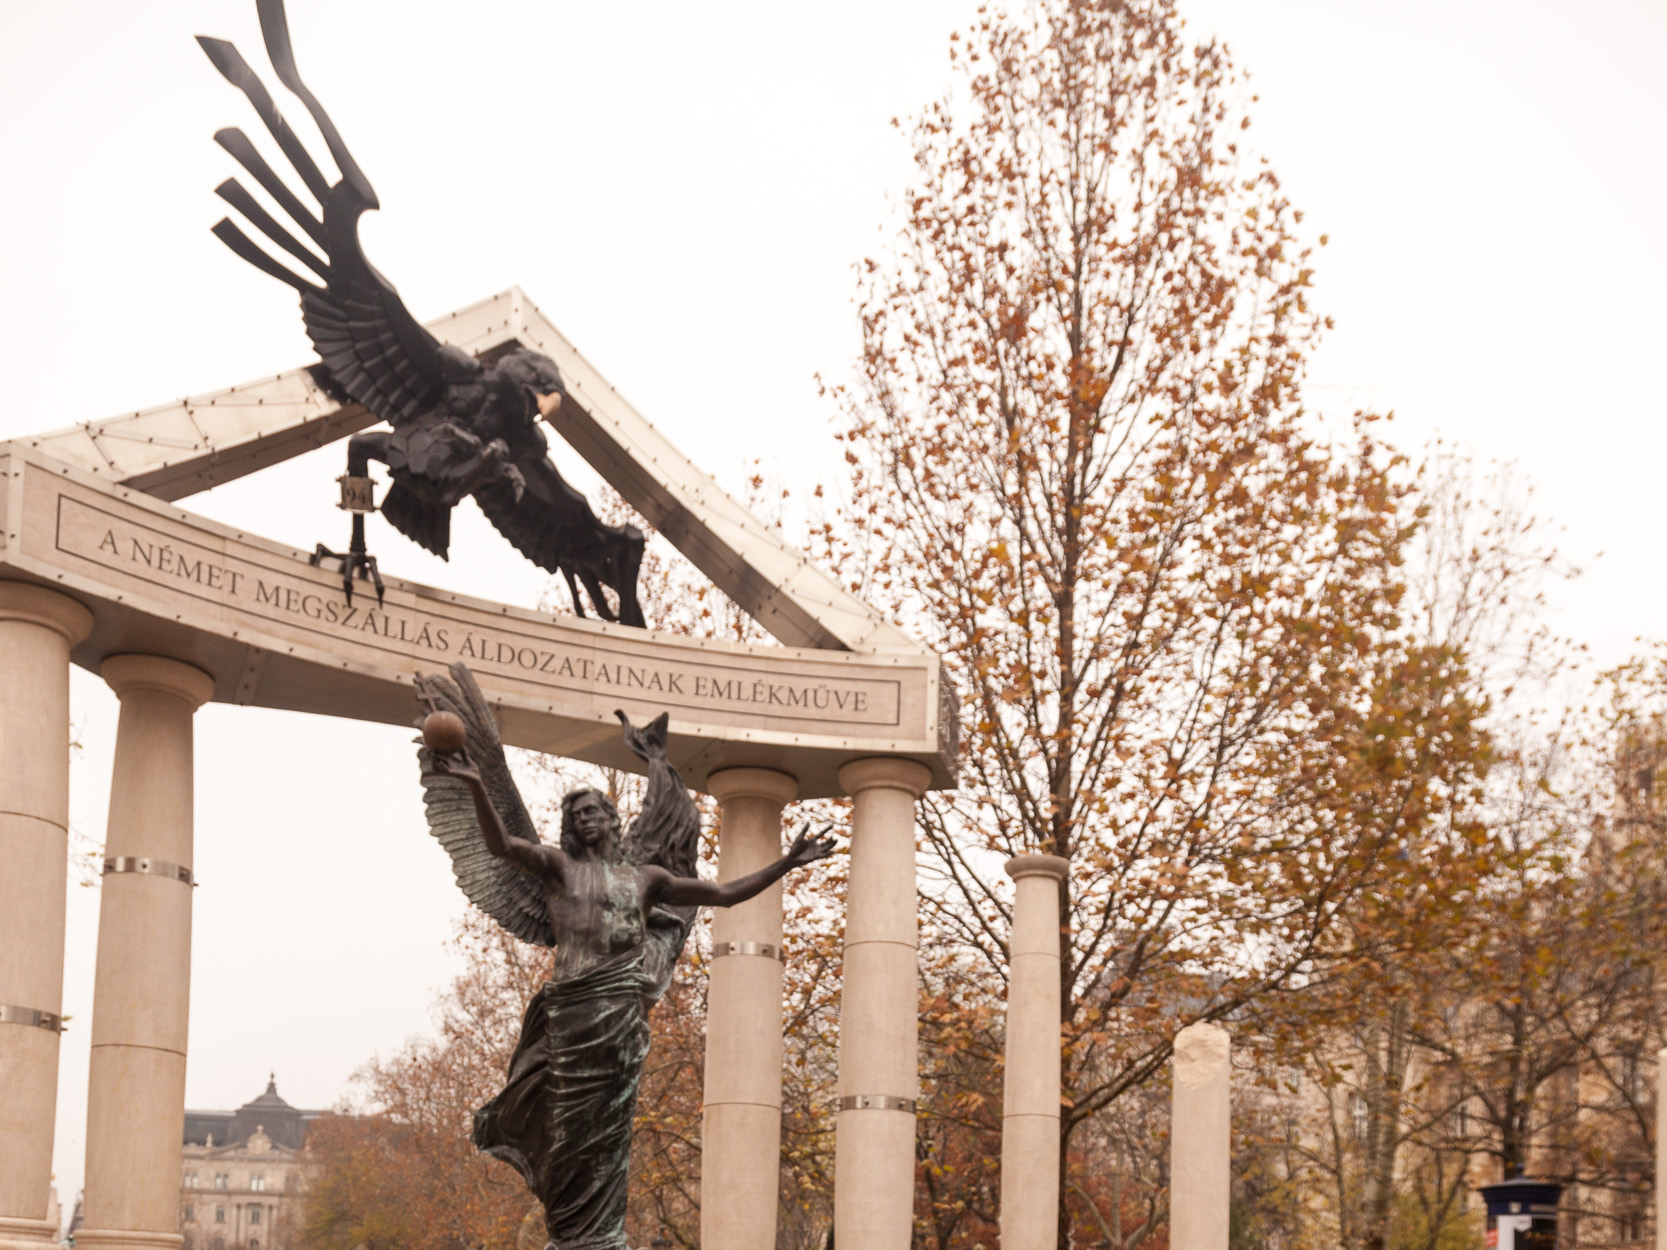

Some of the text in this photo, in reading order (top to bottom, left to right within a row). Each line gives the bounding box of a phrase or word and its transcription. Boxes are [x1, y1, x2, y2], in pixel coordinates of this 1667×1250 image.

[98, 528, 868, 712] A NÉMET MEGSZÁLLÁS ÁLDOZATAINAK EMLÉKMŰVE
